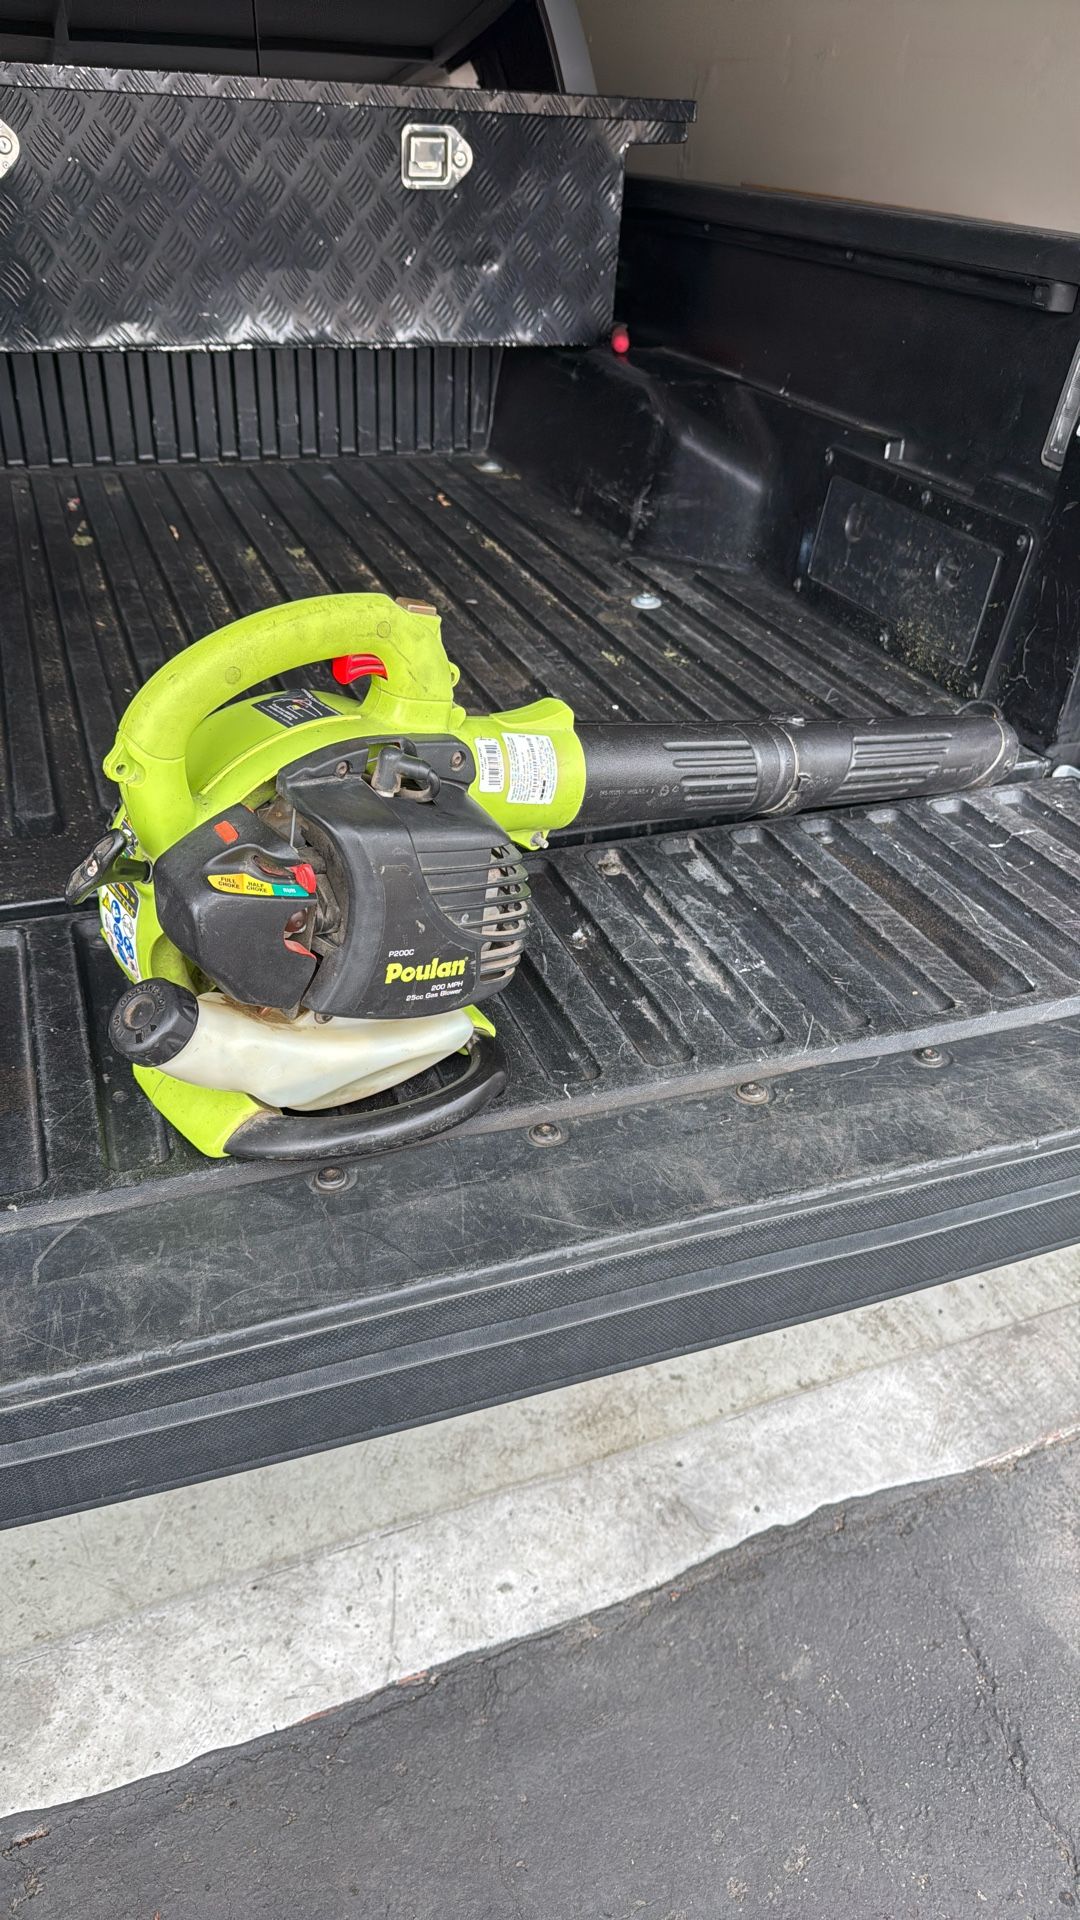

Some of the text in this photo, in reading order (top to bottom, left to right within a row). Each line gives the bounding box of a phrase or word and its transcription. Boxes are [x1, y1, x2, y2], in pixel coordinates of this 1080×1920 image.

[220, 876, 236, 884] FULL
[218, 881, 240, 890] CHOKE
[246, 885, 268, 893] CHOKE
[384, 957, 467, 985] Poulan
[430, 980, 464, 992] 200 MPH
[405, 988, 463, 1002] 25cc Gas Blower
